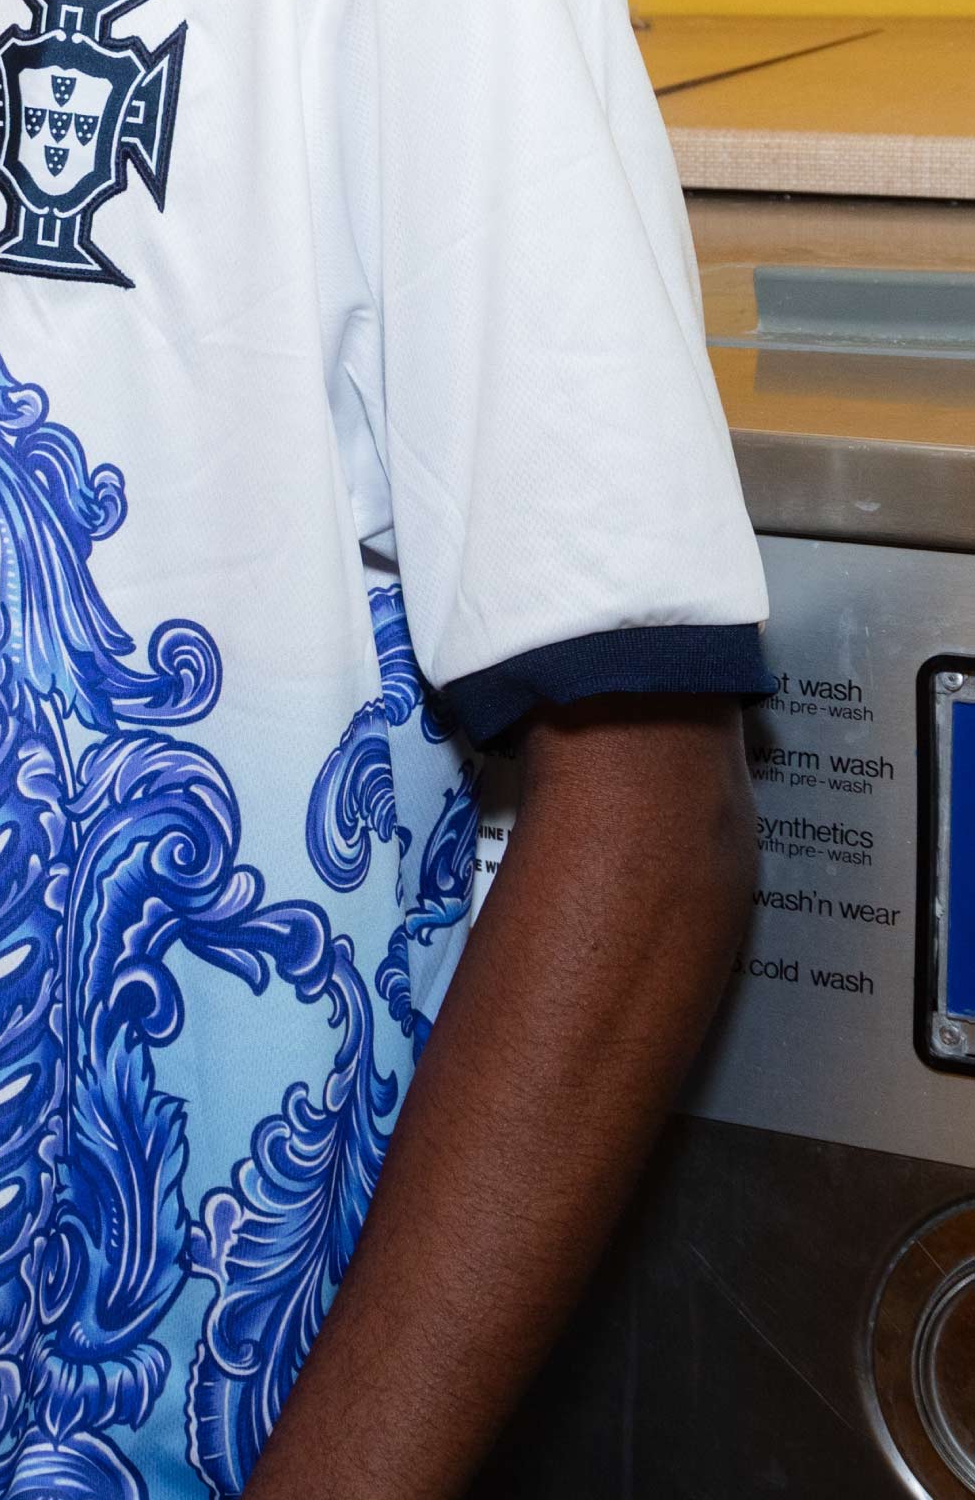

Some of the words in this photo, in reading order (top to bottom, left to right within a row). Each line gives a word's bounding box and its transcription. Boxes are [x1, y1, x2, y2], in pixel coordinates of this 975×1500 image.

[798, 679, 863, 703] wash
[790, 700, 874, 721] pre-wash
[752, 748, 820, 770] warm
[829, 755, 894, 780] wash
[752, 765, 785, 783] with
[790, 772, 873, 795] pre-wash
[788, 842, 873, 866] pre-wash
[839, 901, 902, 926] wear
[810, 969, 874, 995] wash
